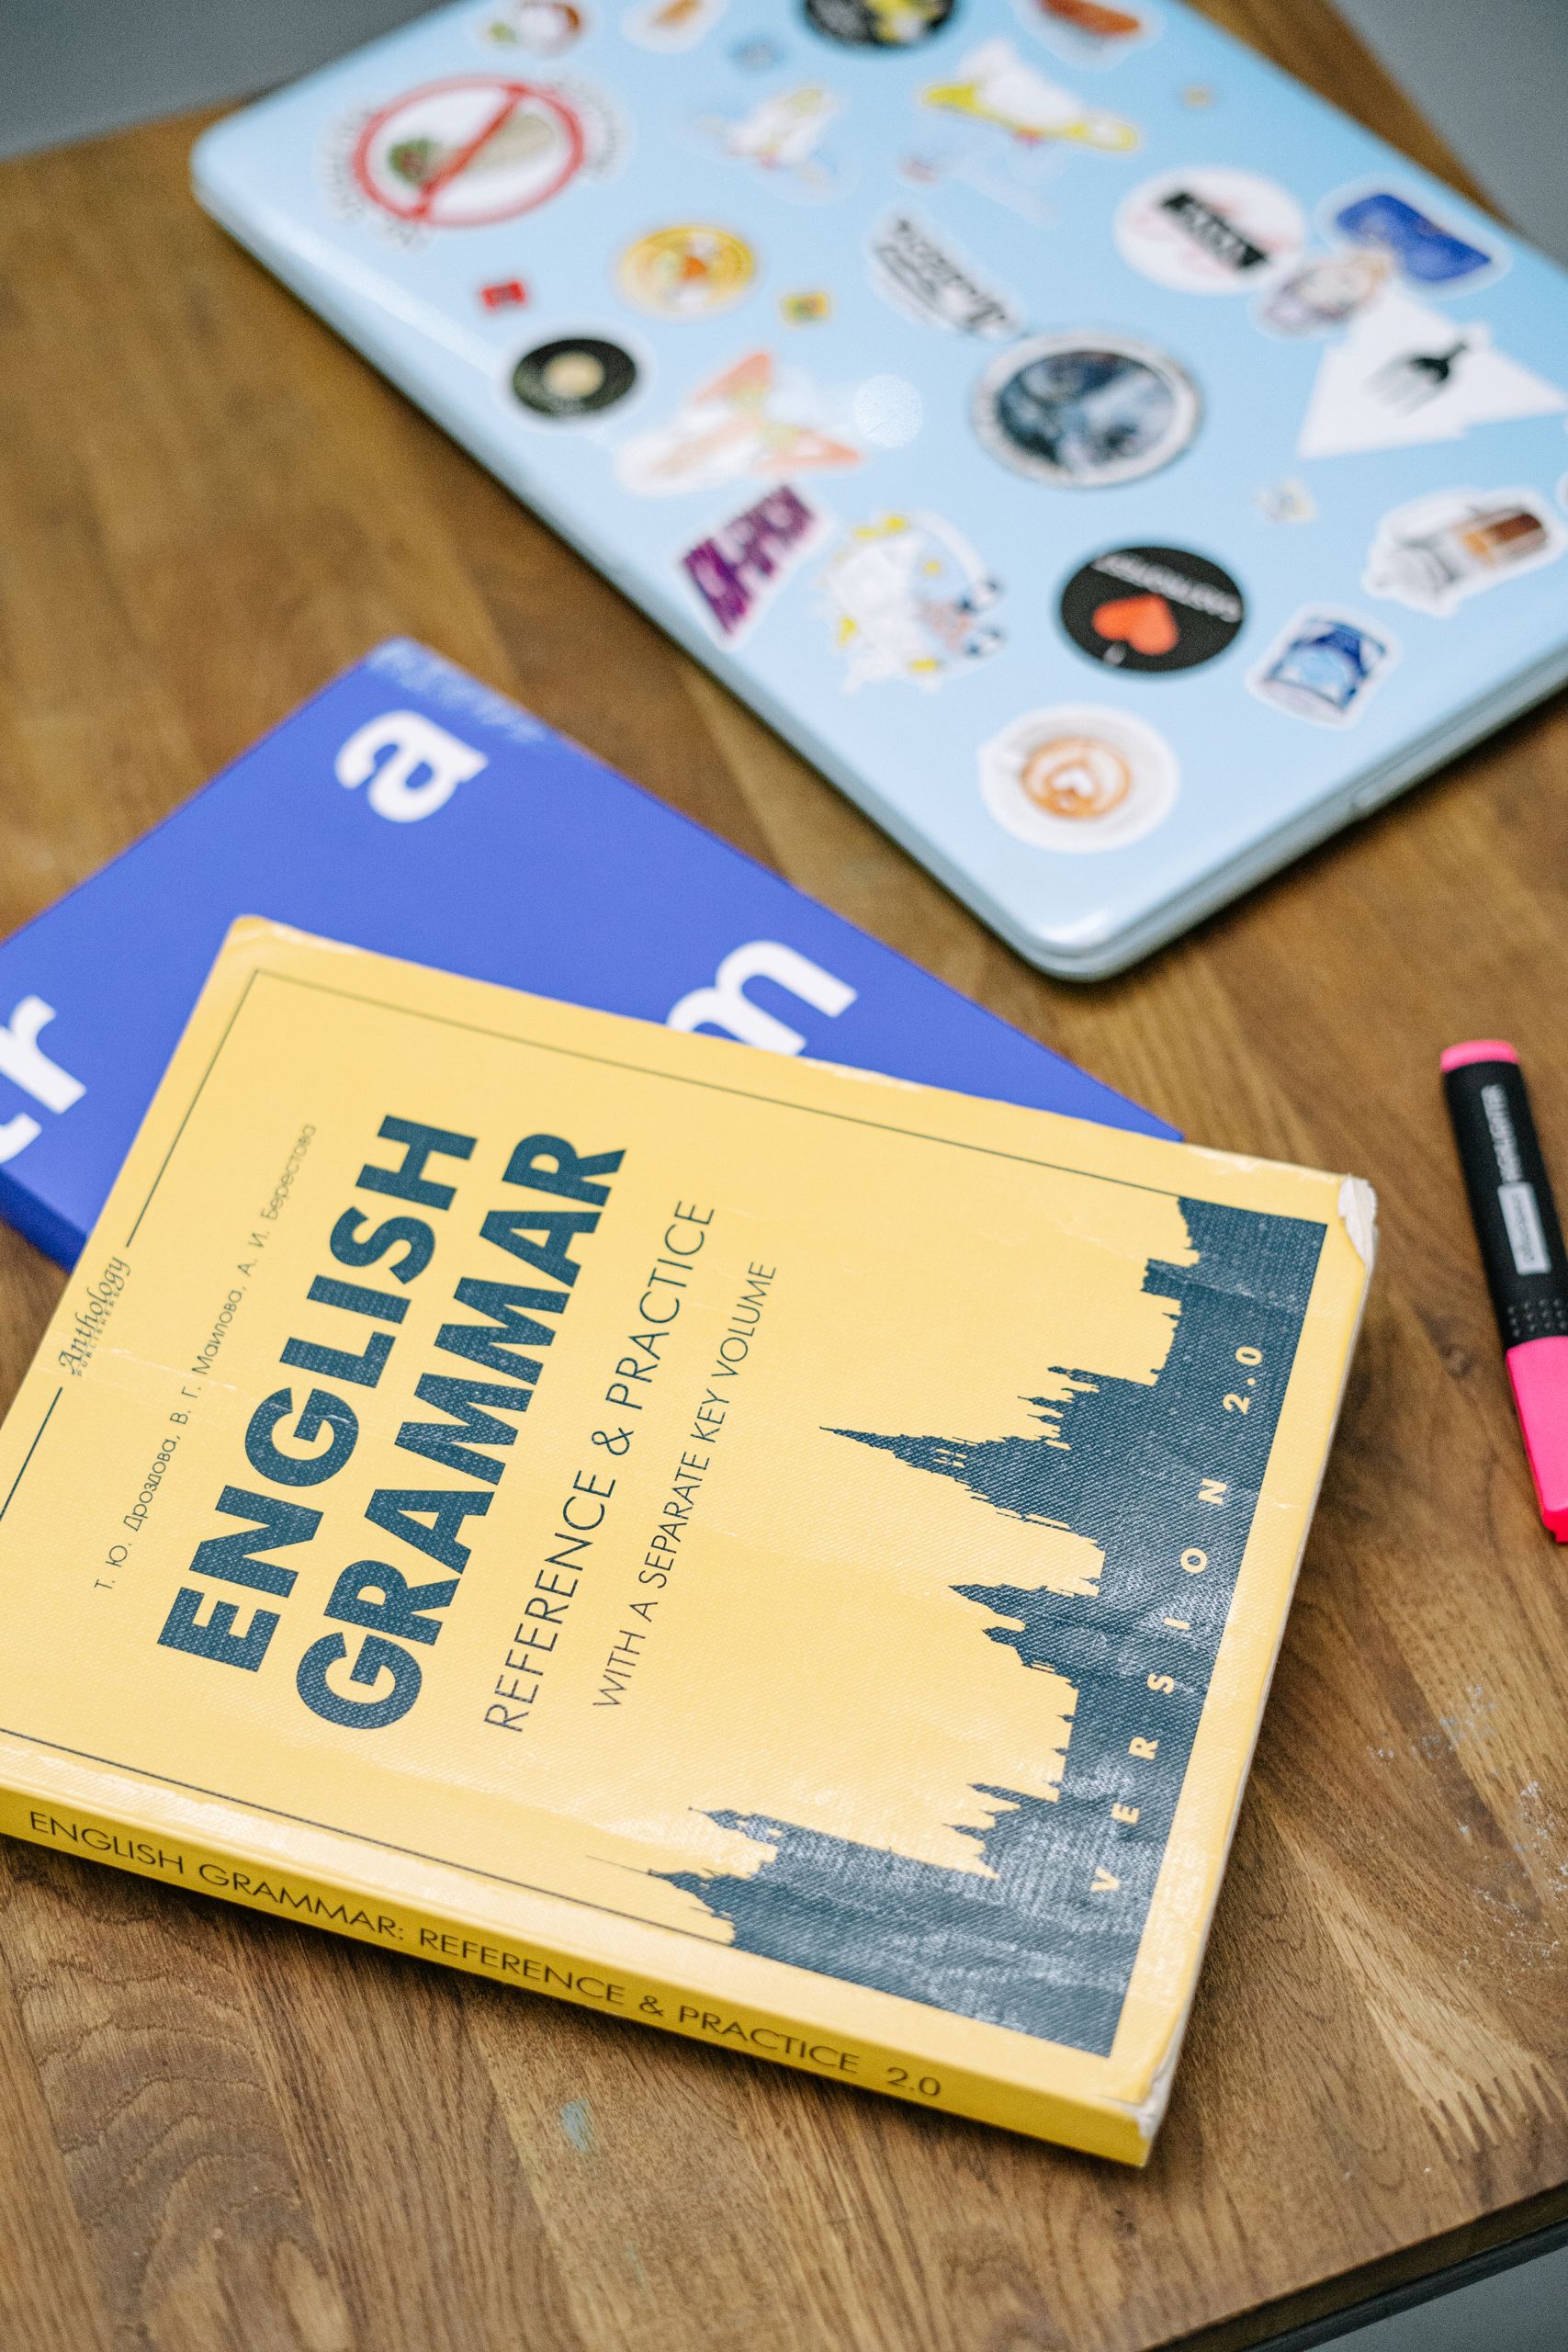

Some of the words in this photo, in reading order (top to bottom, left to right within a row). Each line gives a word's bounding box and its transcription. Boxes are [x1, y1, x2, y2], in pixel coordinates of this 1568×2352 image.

[336, 711, 488, 822] a
[59, 1256, 131, 1375] Anthology
[123, 1434, 181, 1532] Дроздова,
[260, 1124, 317, 1221] Берестова
[605, 1200, 716, 1410] PRACTICE
[711, 1261, 777, 1377] VOLUME
[157, 1114, 479, 1673] ENGLISH
[296, 1133, 626, 1730] GRAMMAR
[691, 1387, 730, 1443] KEY
[1223, 1346, 1263, 1416] 2.0
[591, 1426, 636, 1458] &
[638, 1451, 711, 1589] SEPARATE
[484, 1469, 617, 1733] REFERENCE
[629, 1601, 659, 1624] A
[592, 1629, 647, 1706] WITH
[30, 1810, 184, 1874] ENGLISH
[199, 1863, 403, 1940] GRAMMAR:
[421, 1928, 626, 2006] REFERENCE
[638, 1995, 665, 2018] &
[680, 2005, 860, 2074] PRACTICE
[886, 2066, 942, 2097] 2.0
